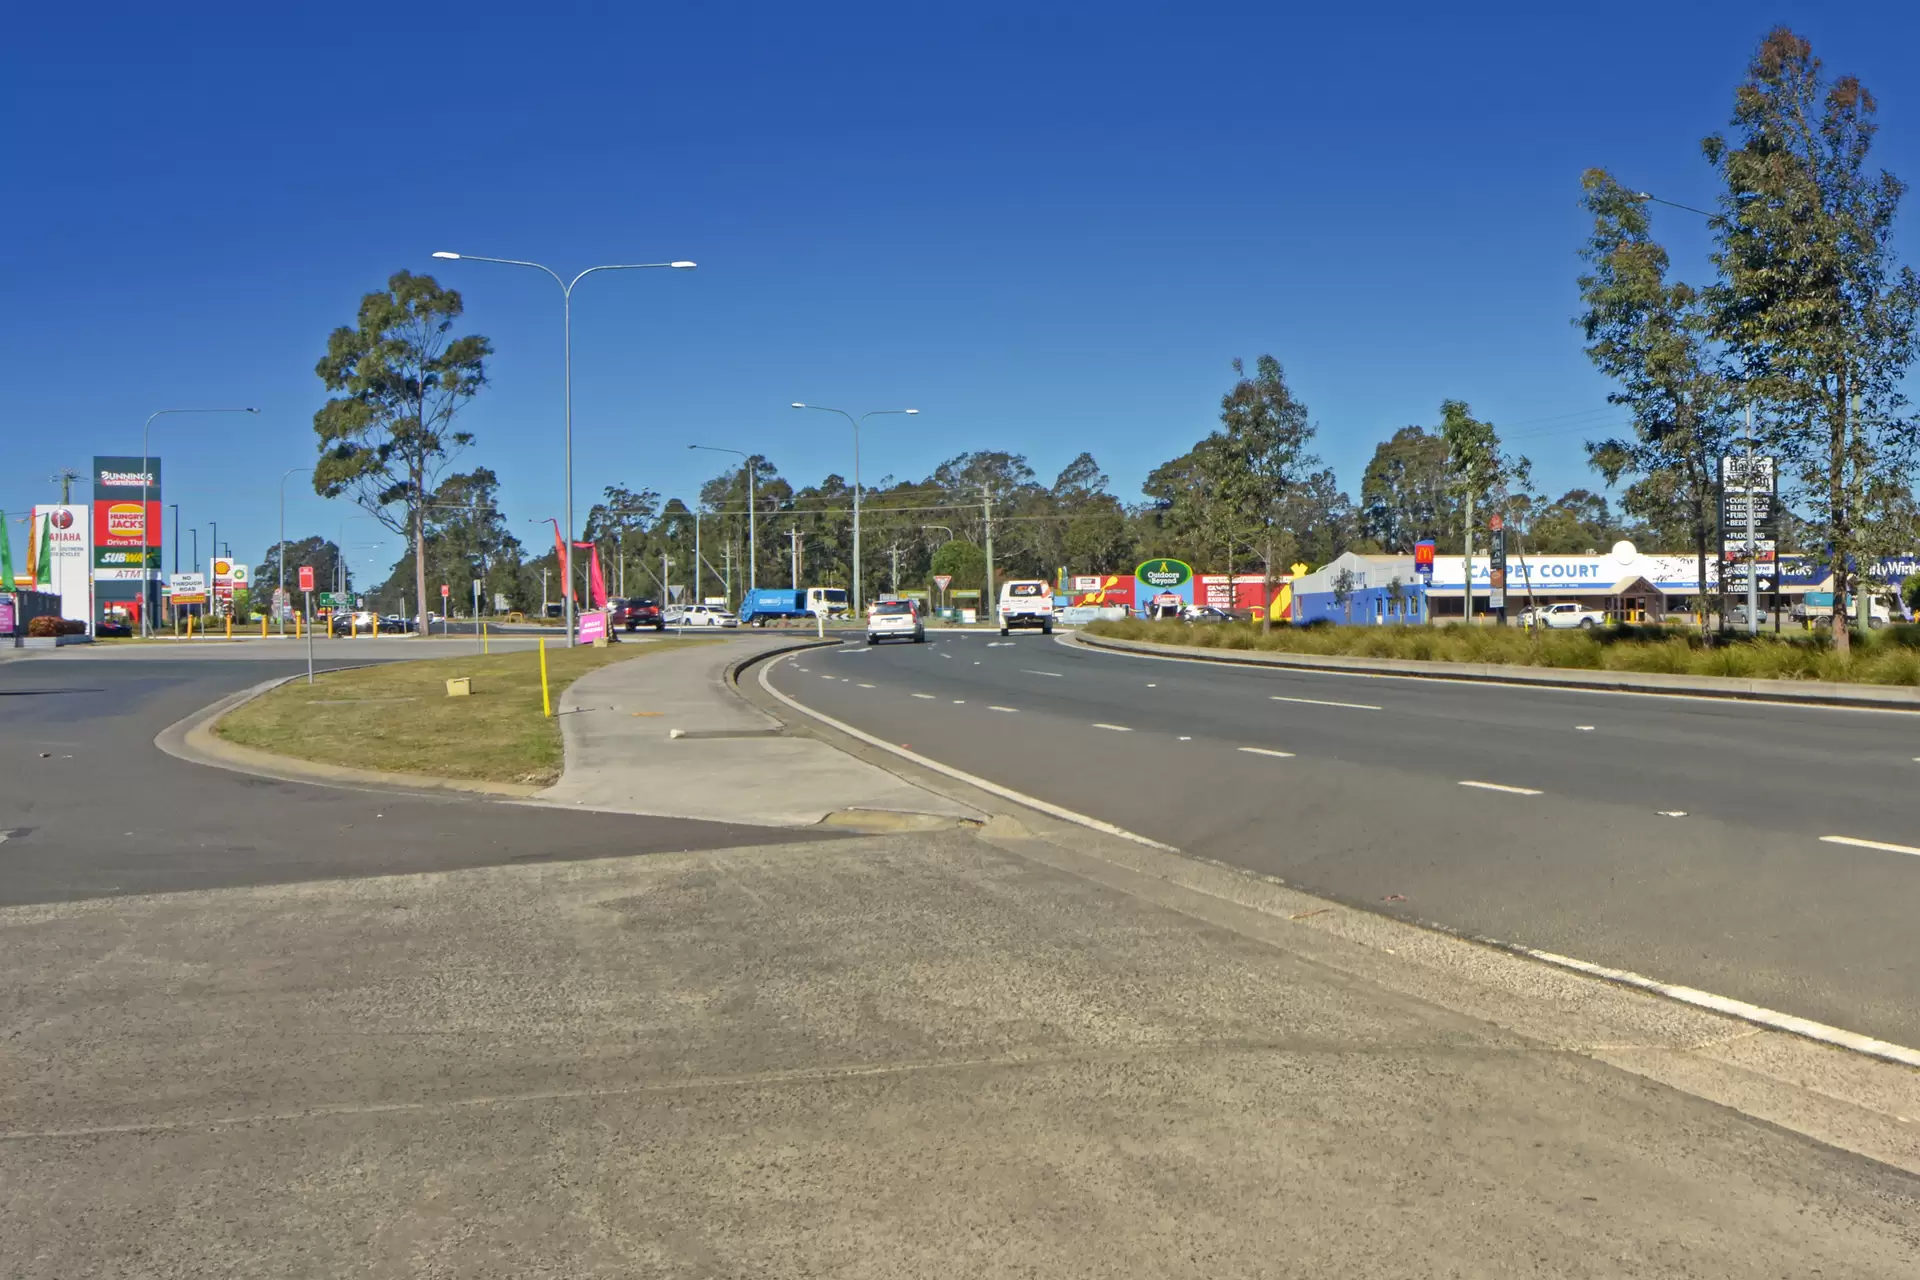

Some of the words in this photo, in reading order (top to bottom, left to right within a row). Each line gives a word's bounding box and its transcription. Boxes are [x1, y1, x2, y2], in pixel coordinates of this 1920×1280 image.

[101, 471, 153, 480] BUNNINGS
[49, 533, 81, 541] AMAHA
[101, 552, 155, 563] SUBWA
[115, 570, 141, 578] ATM
[1470, 564, 1534, 578] CAPET
[1540, 564, 1599, 578] COURT
[1151, 577, 1177, 585] Beyond
